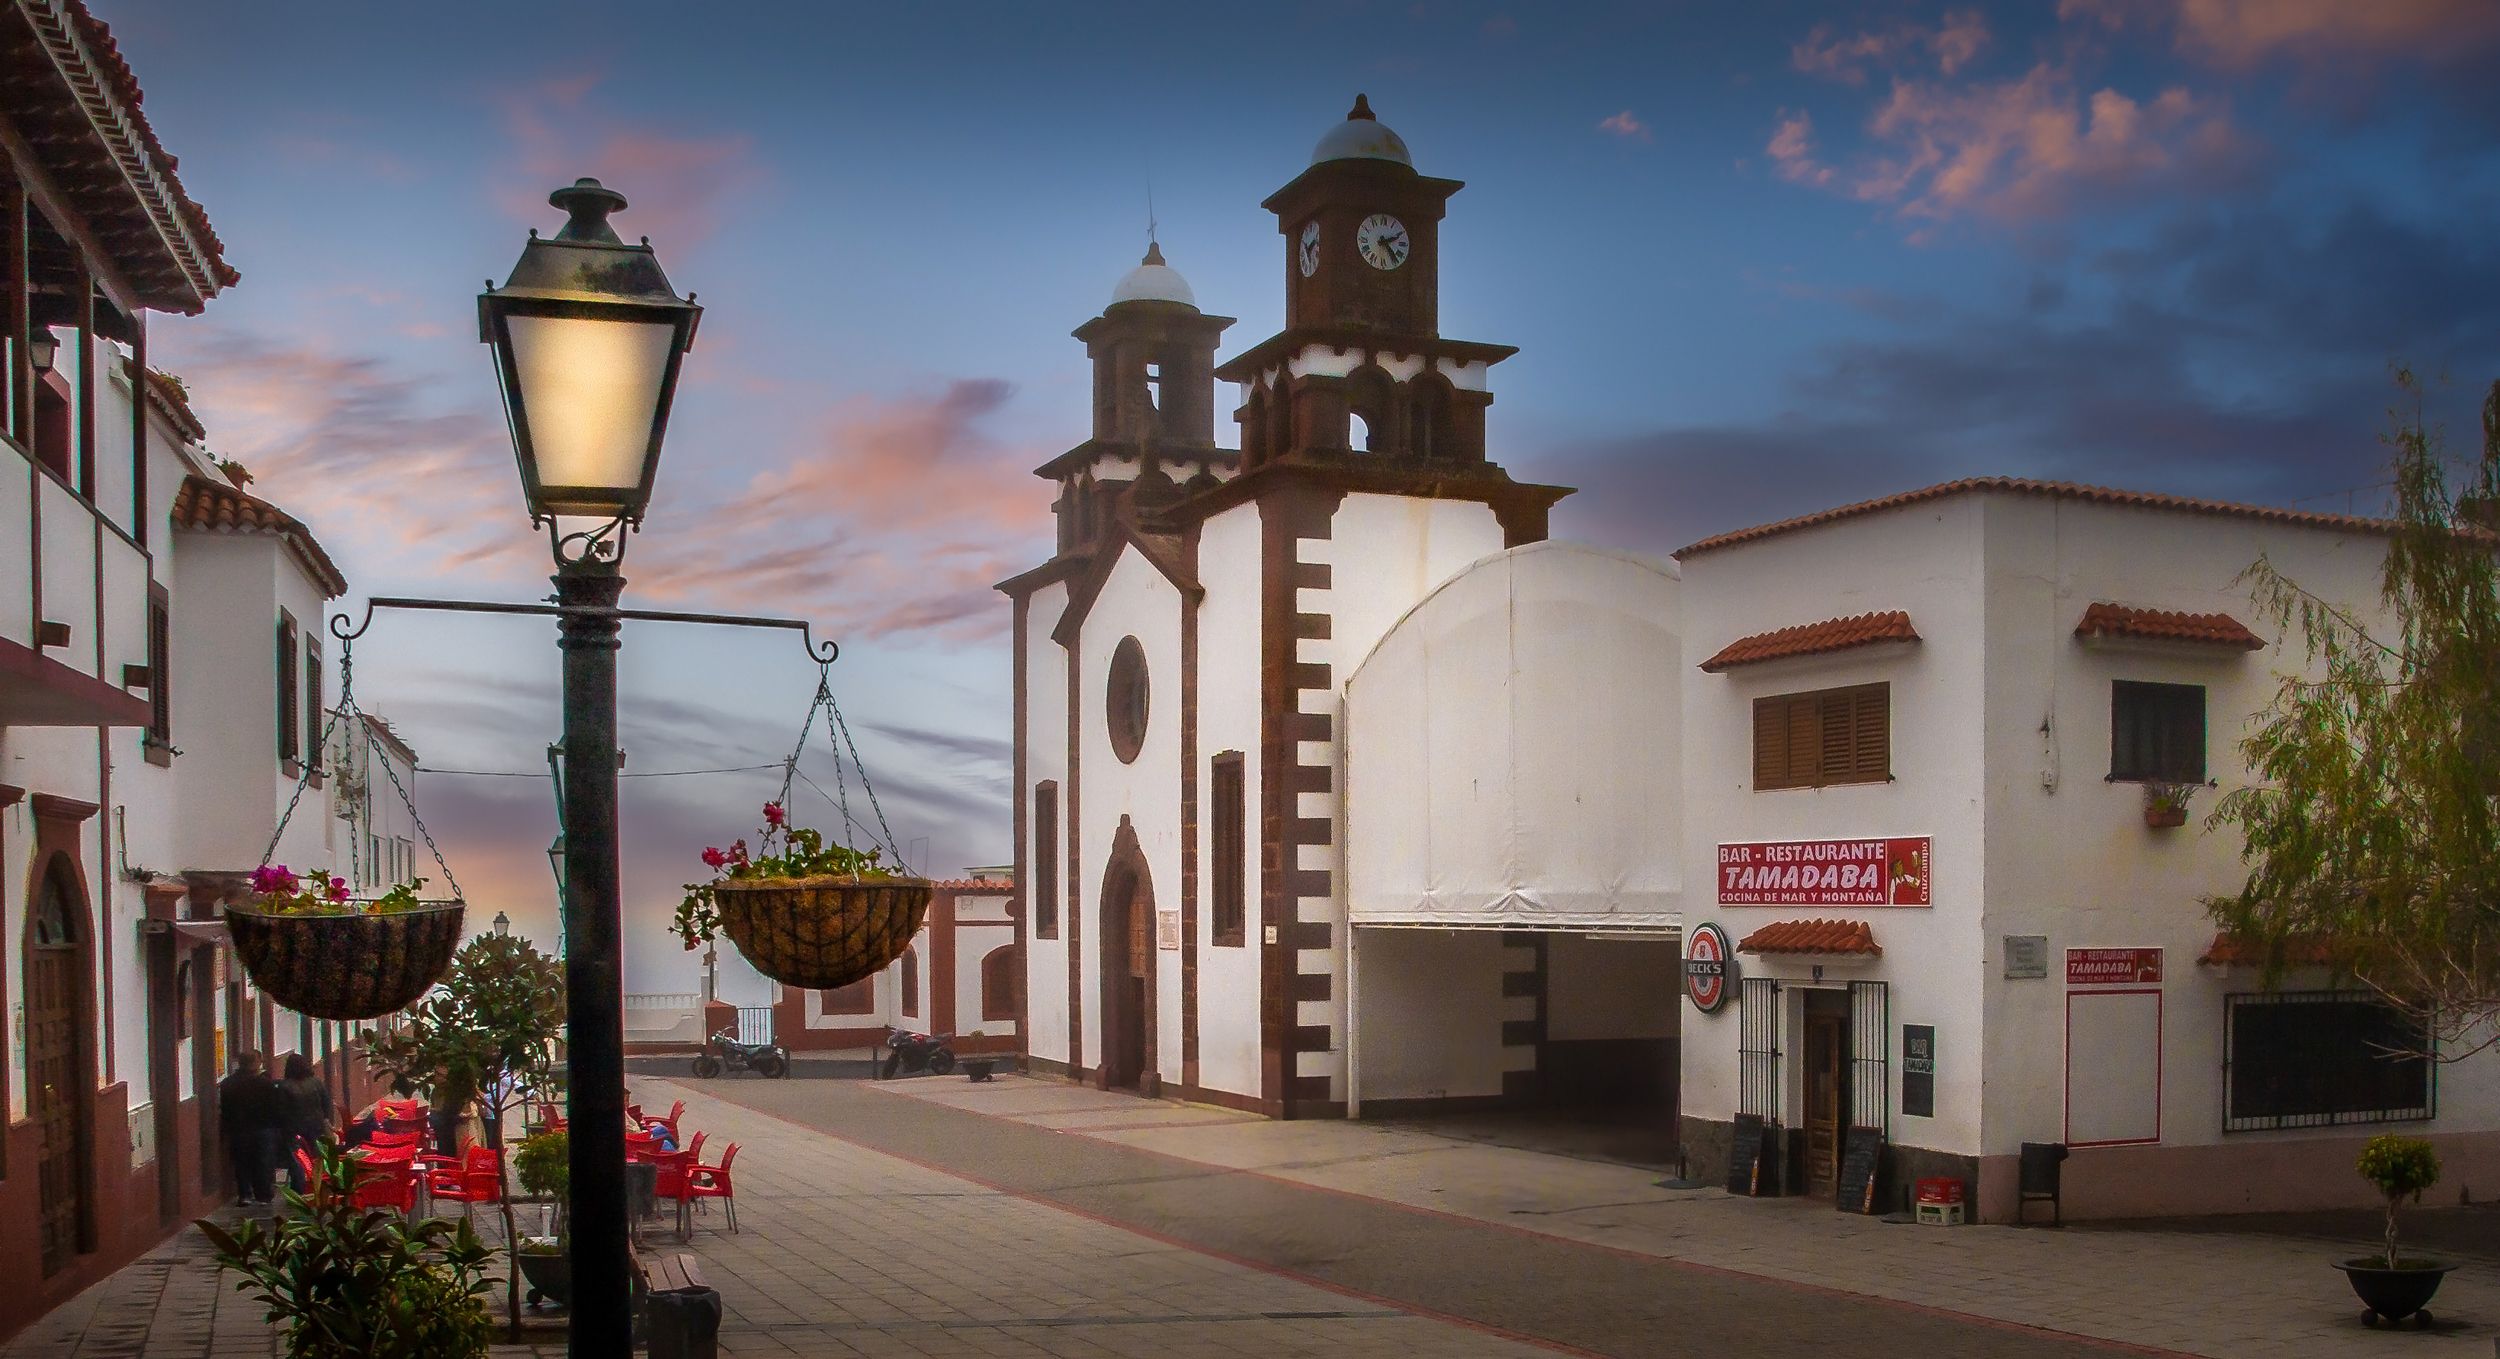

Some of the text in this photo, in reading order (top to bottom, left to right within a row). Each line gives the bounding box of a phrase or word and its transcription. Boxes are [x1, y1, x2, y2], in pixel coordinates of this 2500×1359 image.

[1719, 847, 1750, 863] BAR
[1766, 842, 1884, 862] RESTAURANTE
[1725, 864, 1878, 889] TAMADABA
[1920, 841, 1928, 902] Cruzcampo
[1720, 889, 1884, 902] COCINA DE MAR Y MONTAÑA
[2067, 951, 2082, 960] BAR
[1687, 963, 1721, 974] BECK'S
[2070, 962, 2132, 974] TAMADABA
